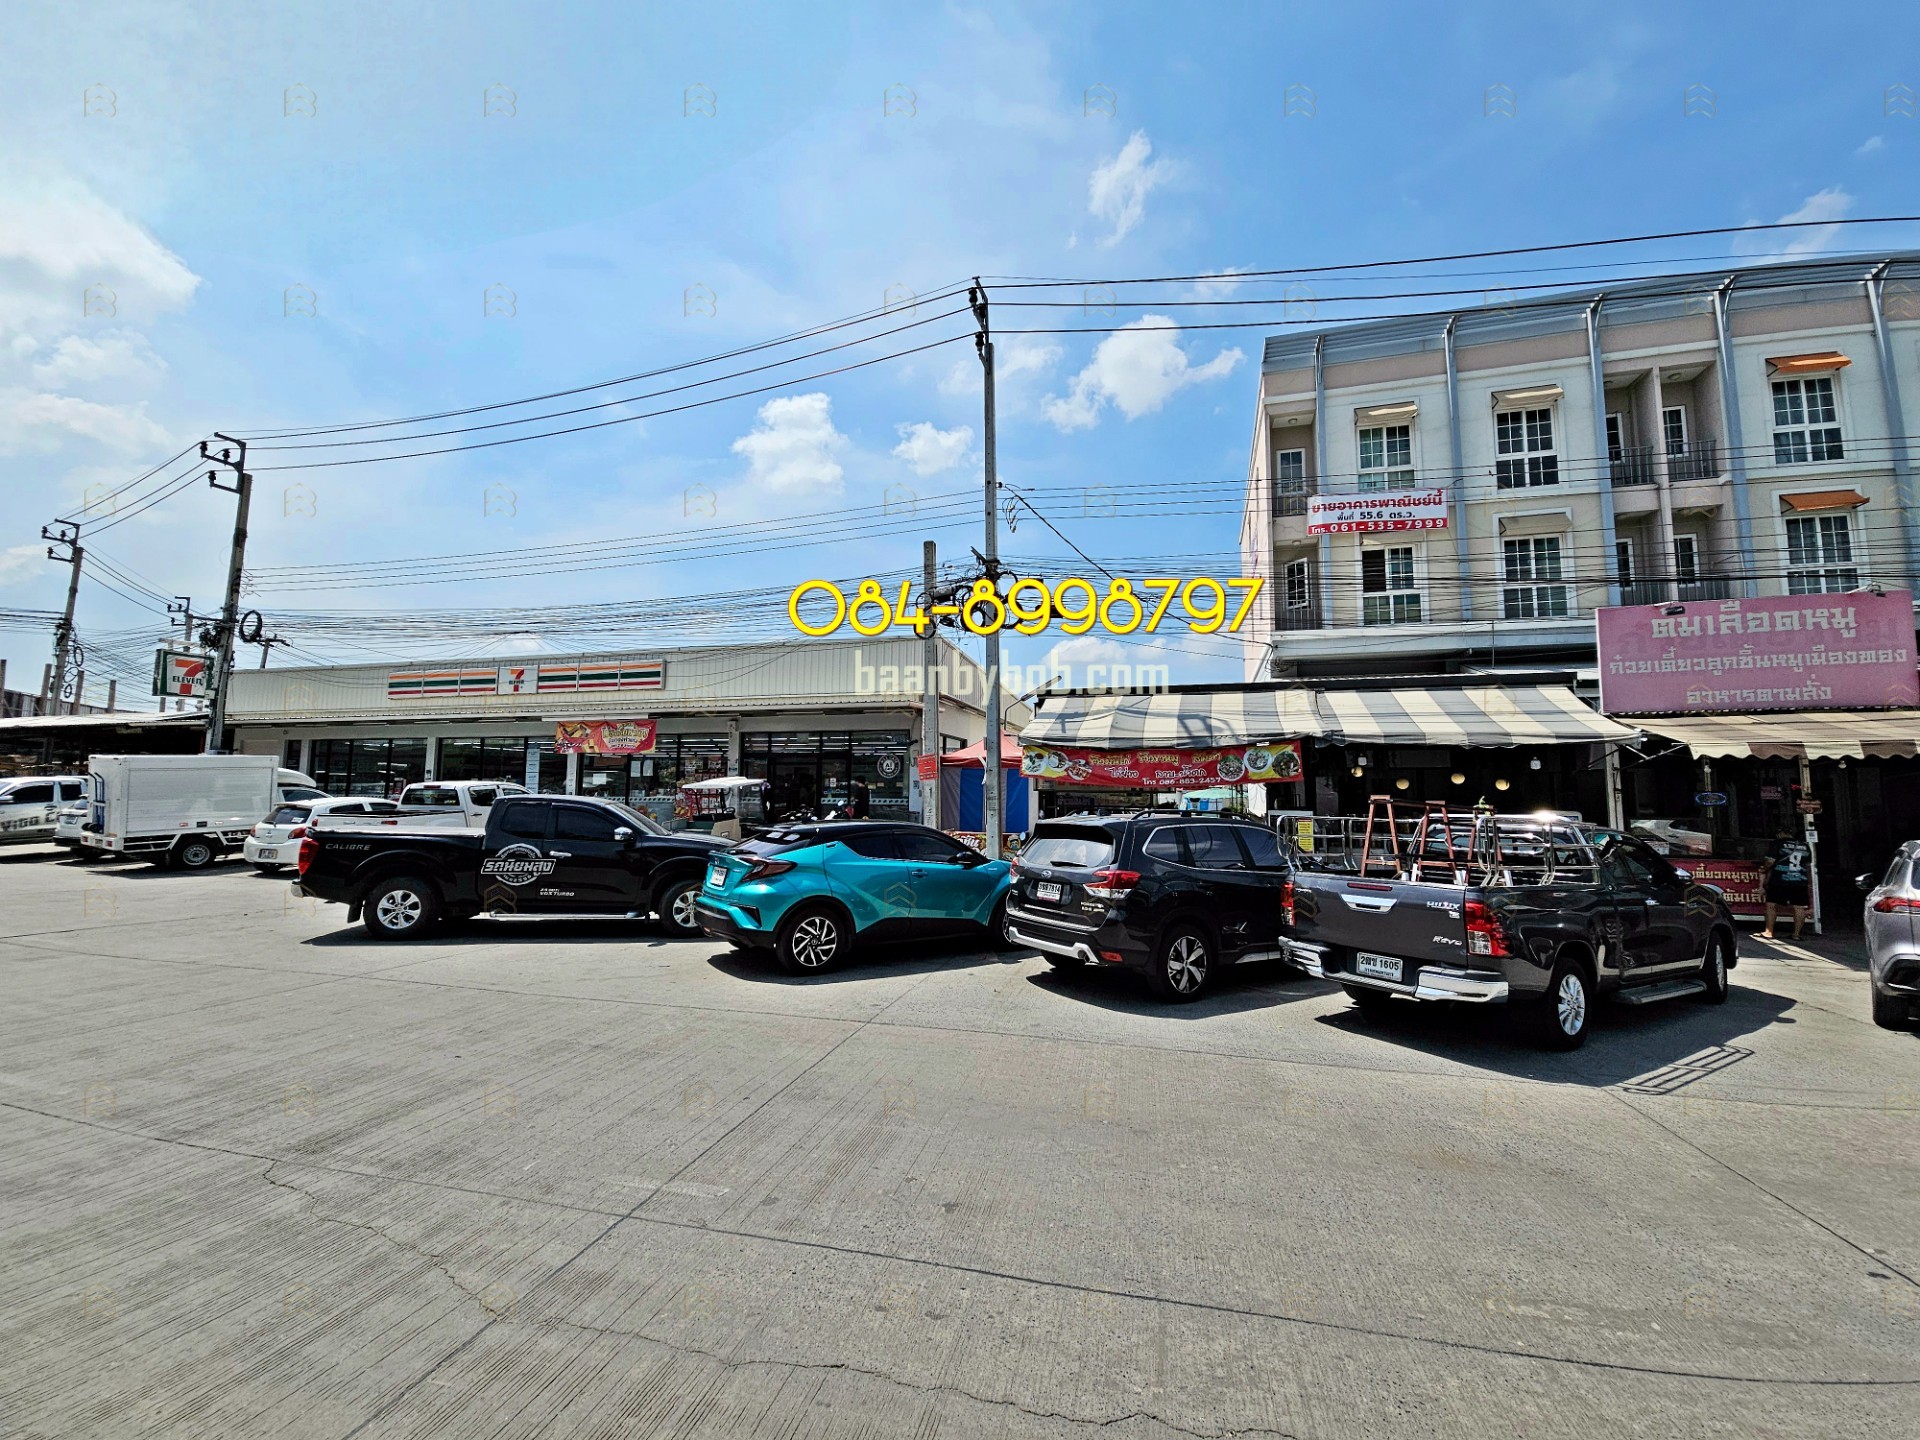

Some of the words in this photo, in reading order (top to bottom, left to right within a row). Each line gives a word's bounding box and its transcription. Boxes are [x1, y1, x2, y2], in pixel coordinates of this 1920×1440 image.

[1312, 489, 1443, 513] ขายอาคารพาณิชย์นี้
[1337, 511, 1354, 521] พื้นที่
[1360, 511, 1383, 520] 55.6
[1389, 511, 1416, 519] ตร.ว.
[1310, 526, 1328, 534] โทร.
[1330, 519, 1444, 532] 061-535-7999
[1609, 644, 1908, 676] ก๋วยเตี๋ยวลูกชิ้นหมูเมืองทอง
[1686, 674, 1832, 704] อาหารตามสั่ง
[325, 843, 371, 851] CALIBRE
[1379, 959, 1400, 971] 1605
